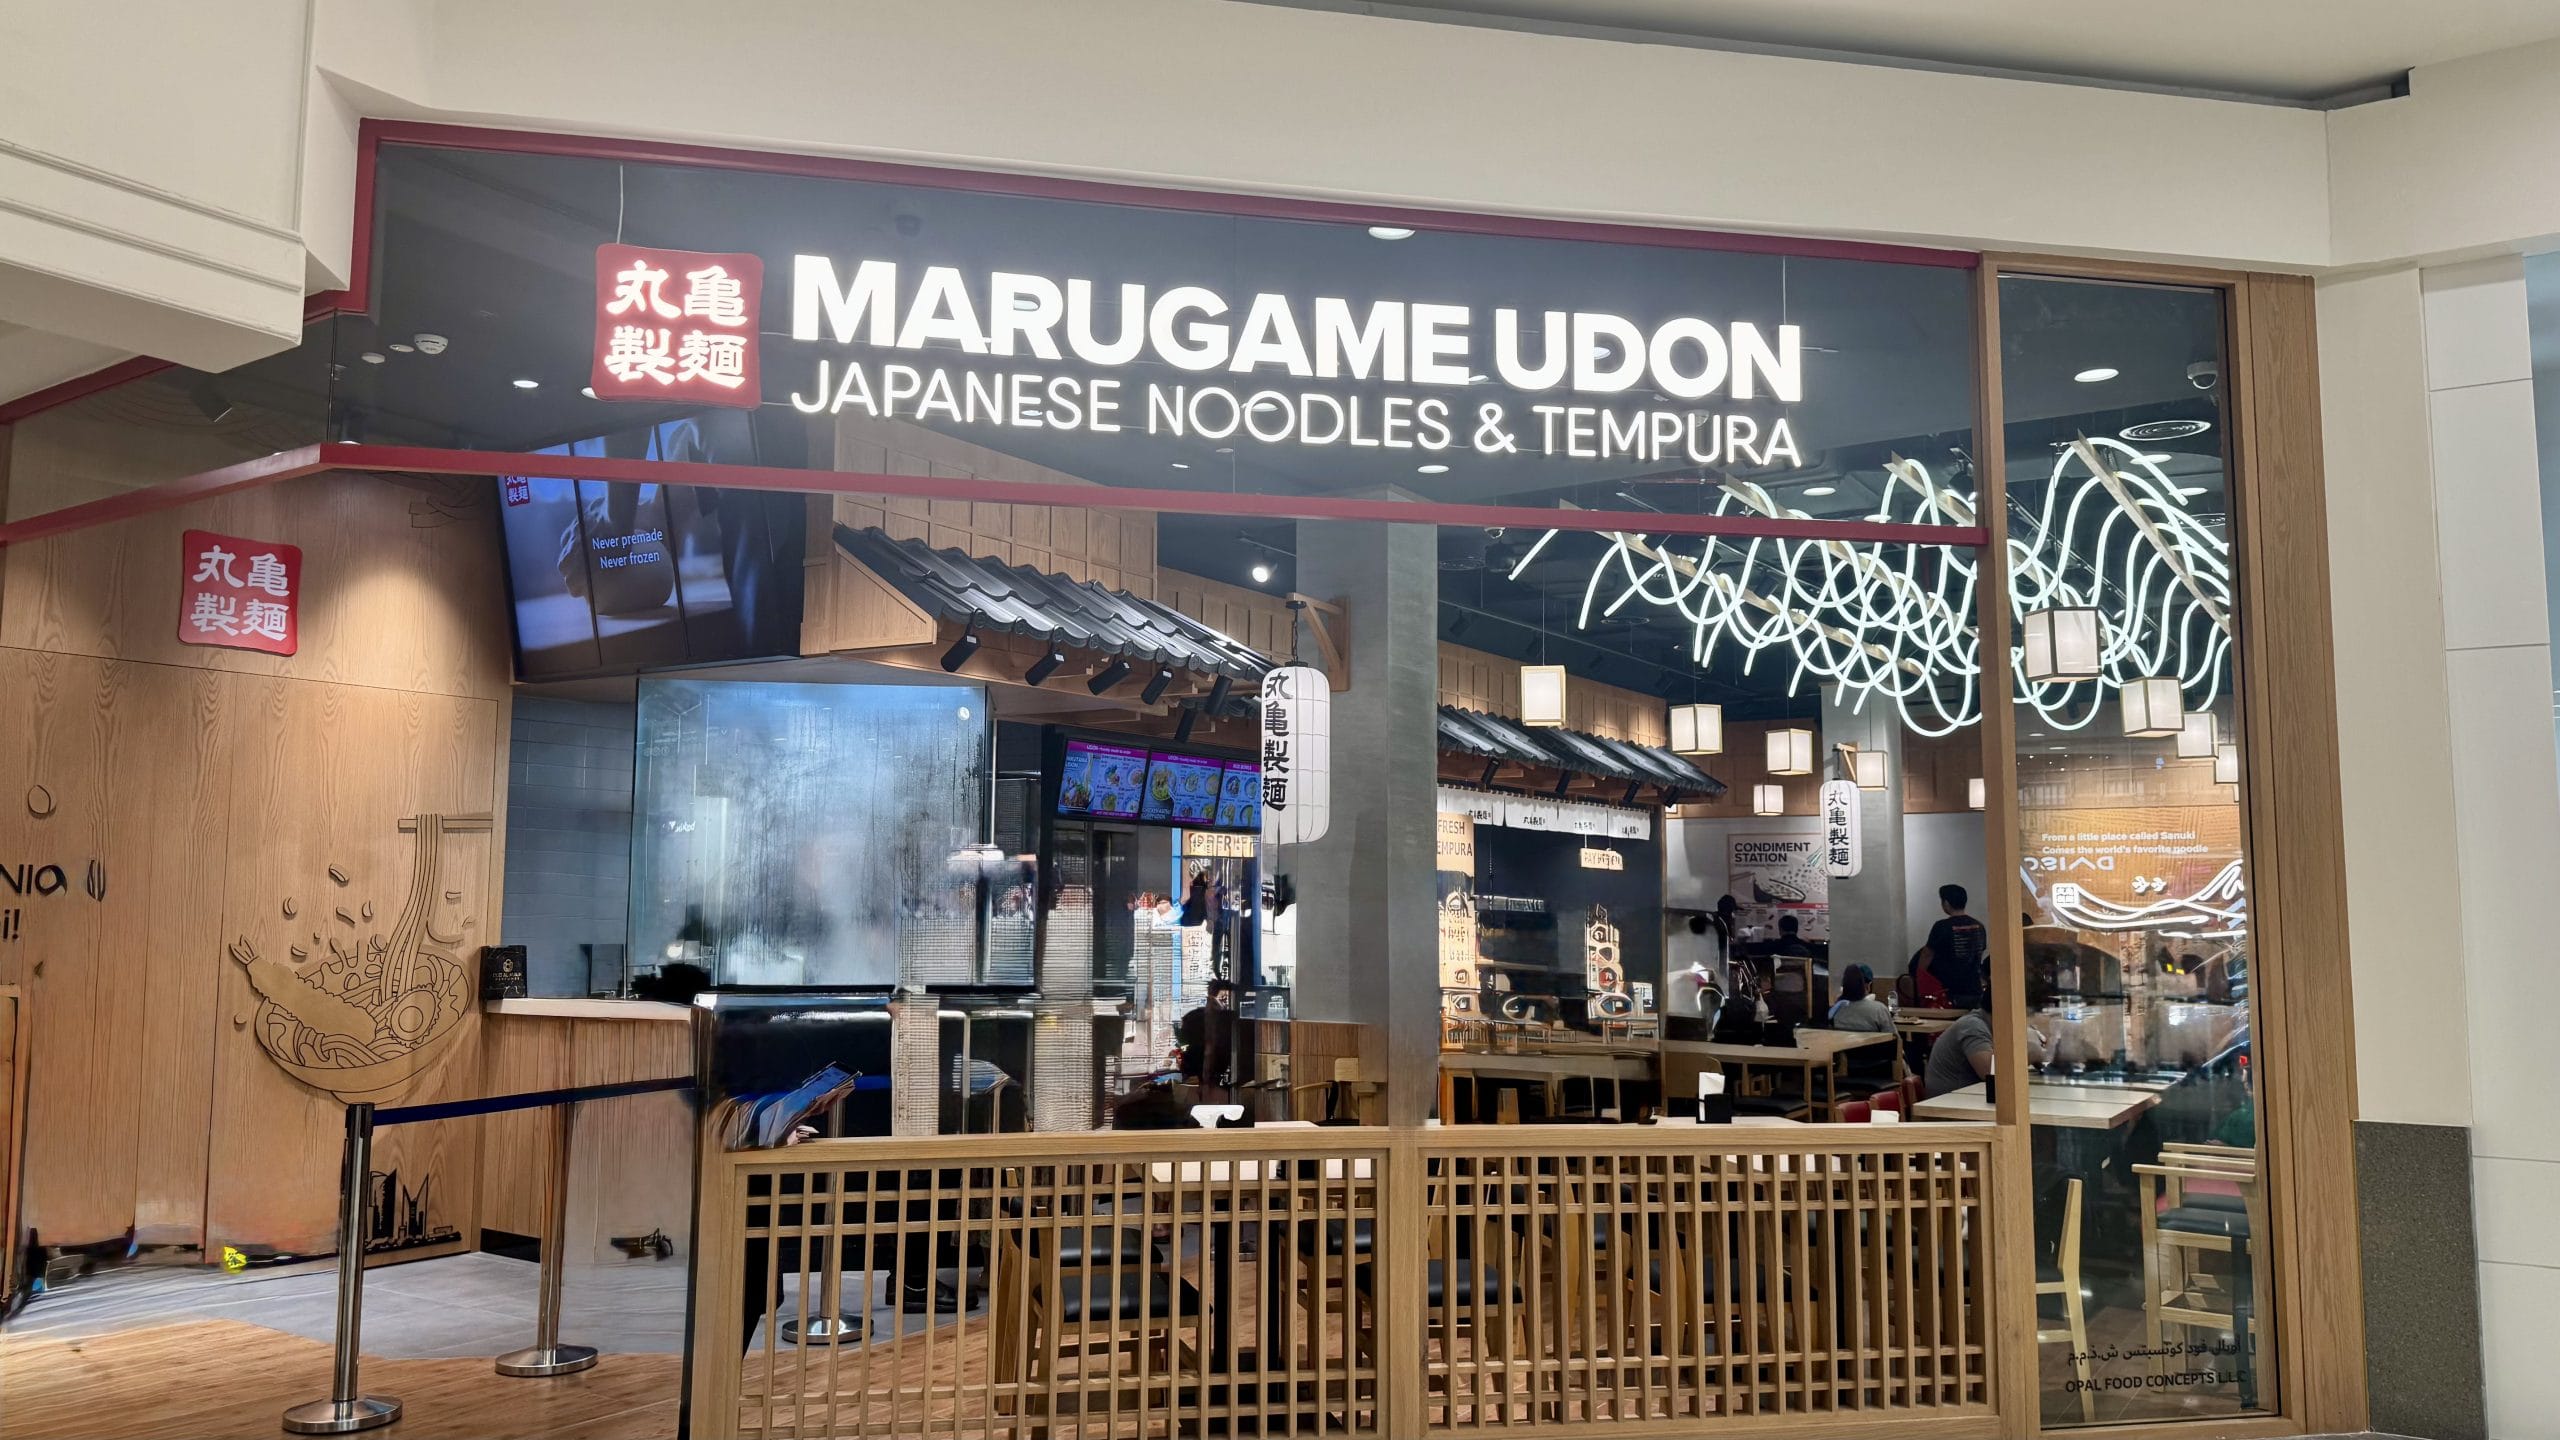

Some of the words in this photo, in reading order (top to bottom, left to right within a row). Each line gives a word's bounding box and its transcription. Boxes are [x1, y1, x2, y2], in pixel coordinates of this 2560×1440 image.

[605, 260, 747, 327] 丸亀
[791, 253, 1471, 386] MARUGAME
[1493, 307, 1803, 402] UDON
[790, 358, 1122, 433] JAPANESE
[1146, 383, 1452, 454] NOODLES
[1472, 401, 1518, 456] &
[1532, 404, 1802, 469] TEMPURA
[592, 537, 619, 549] Never
[621, 528, 663, 549] premade
[600, 555, 627, 569] Never
[629, 551, 660, 565] frozen
[192, 544, 290, 597] 丸亀
[1437, 820, 1465, 835] FRESH
[1828, 790, 1850, 866] 丸亀製麺
[2042, 834, 2067, 842] From
[2077, 832, 2099, 842] little
[2101, 832, 2127, 843] place
[2129, 831, 2159, 841] called
[2161, 831, 2196, 840] Sanuki
[1436, 841, 1473, 857] EMPURA
[1734, 842, 1811, 853] CONDIMENT
[2042, 846, 2078, 855] Comes
[2081, 845, 2094, 854] the
[2133, 845, 2170, 854] favorite
[2172, 844, 2209, 854] noodle
[1734, 852, 1788, 863] STATION
[2065, 1379, 2102, 1393] OPAL
[2104, 1376, 2143, 1390] FOOD
[2146, 1370, 2215, 1387] CONCEPTS
